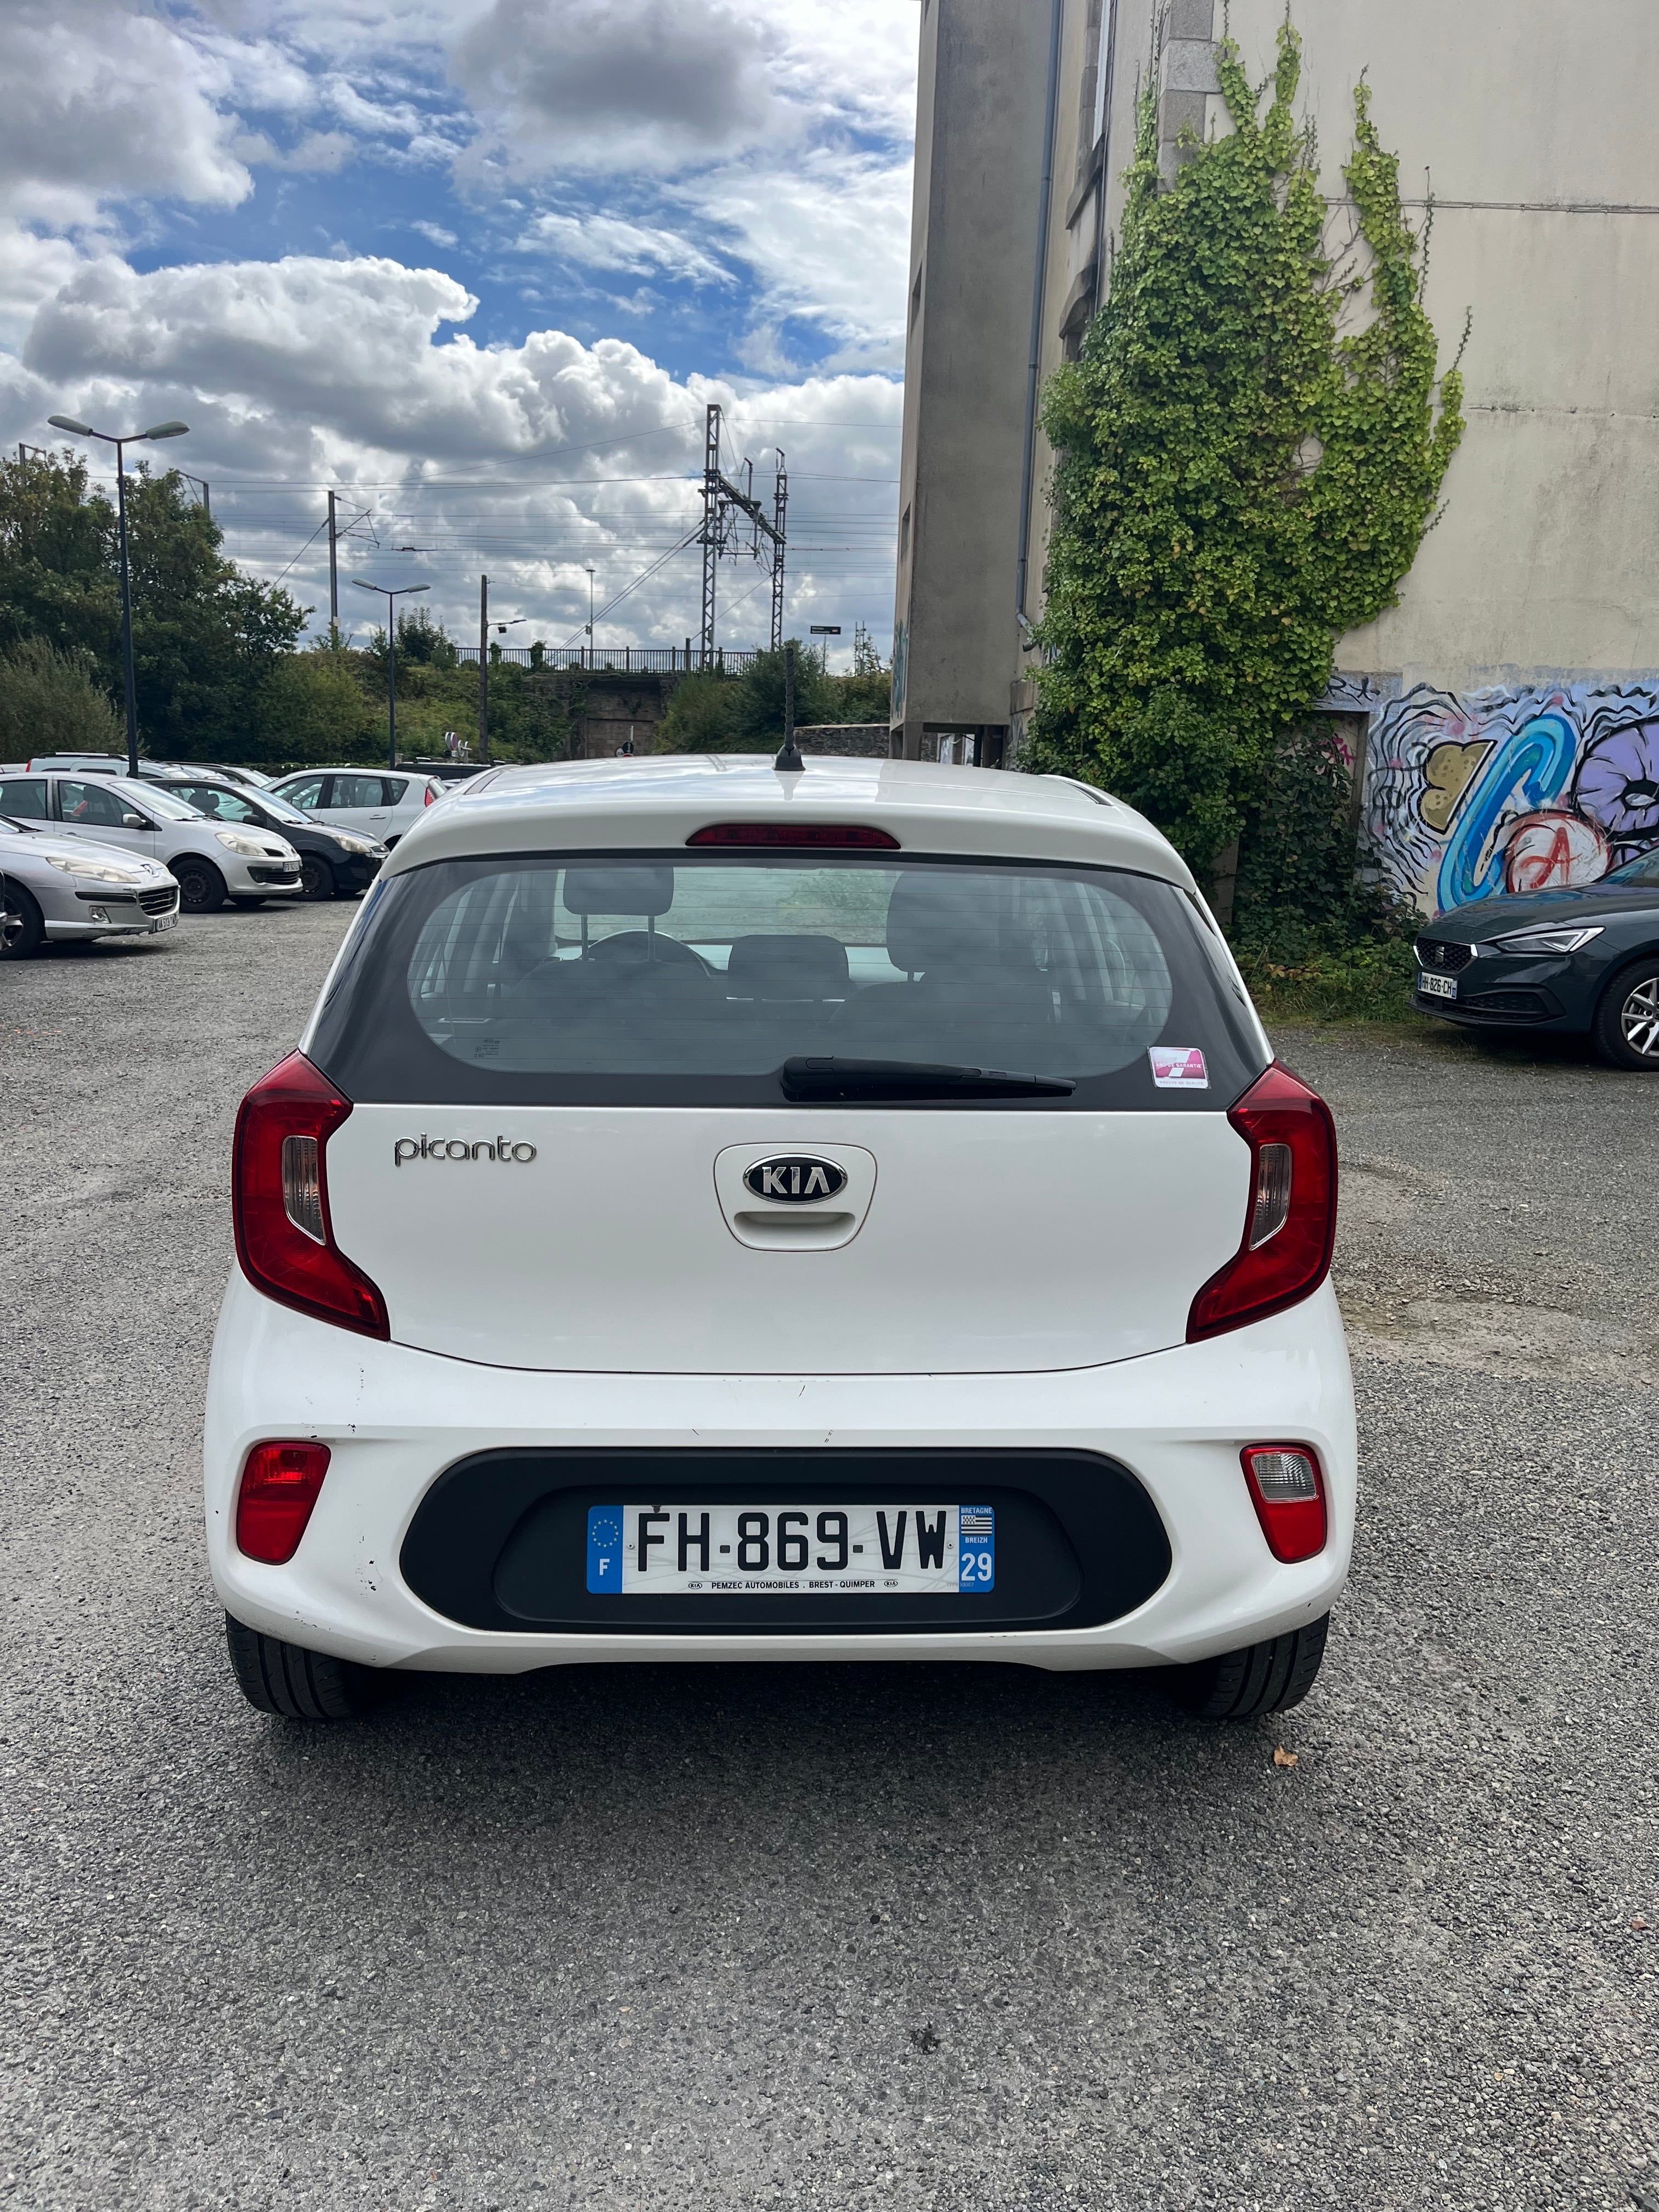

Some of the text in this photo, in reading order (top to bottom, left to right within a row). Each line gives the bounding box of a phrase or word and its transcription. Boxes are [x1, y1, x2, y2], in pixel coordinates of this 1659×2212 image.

[1422, 975, 1452, 995] HH-826-CH
[394, 1132, 537, 1166] picanto
[762, 1167, 830, 1194] KIA
[638, 1511, 946, 1572] FH-869-VW
[599, 1558, 611, 1576] F
[961, 1553, 992, 1581] 29
